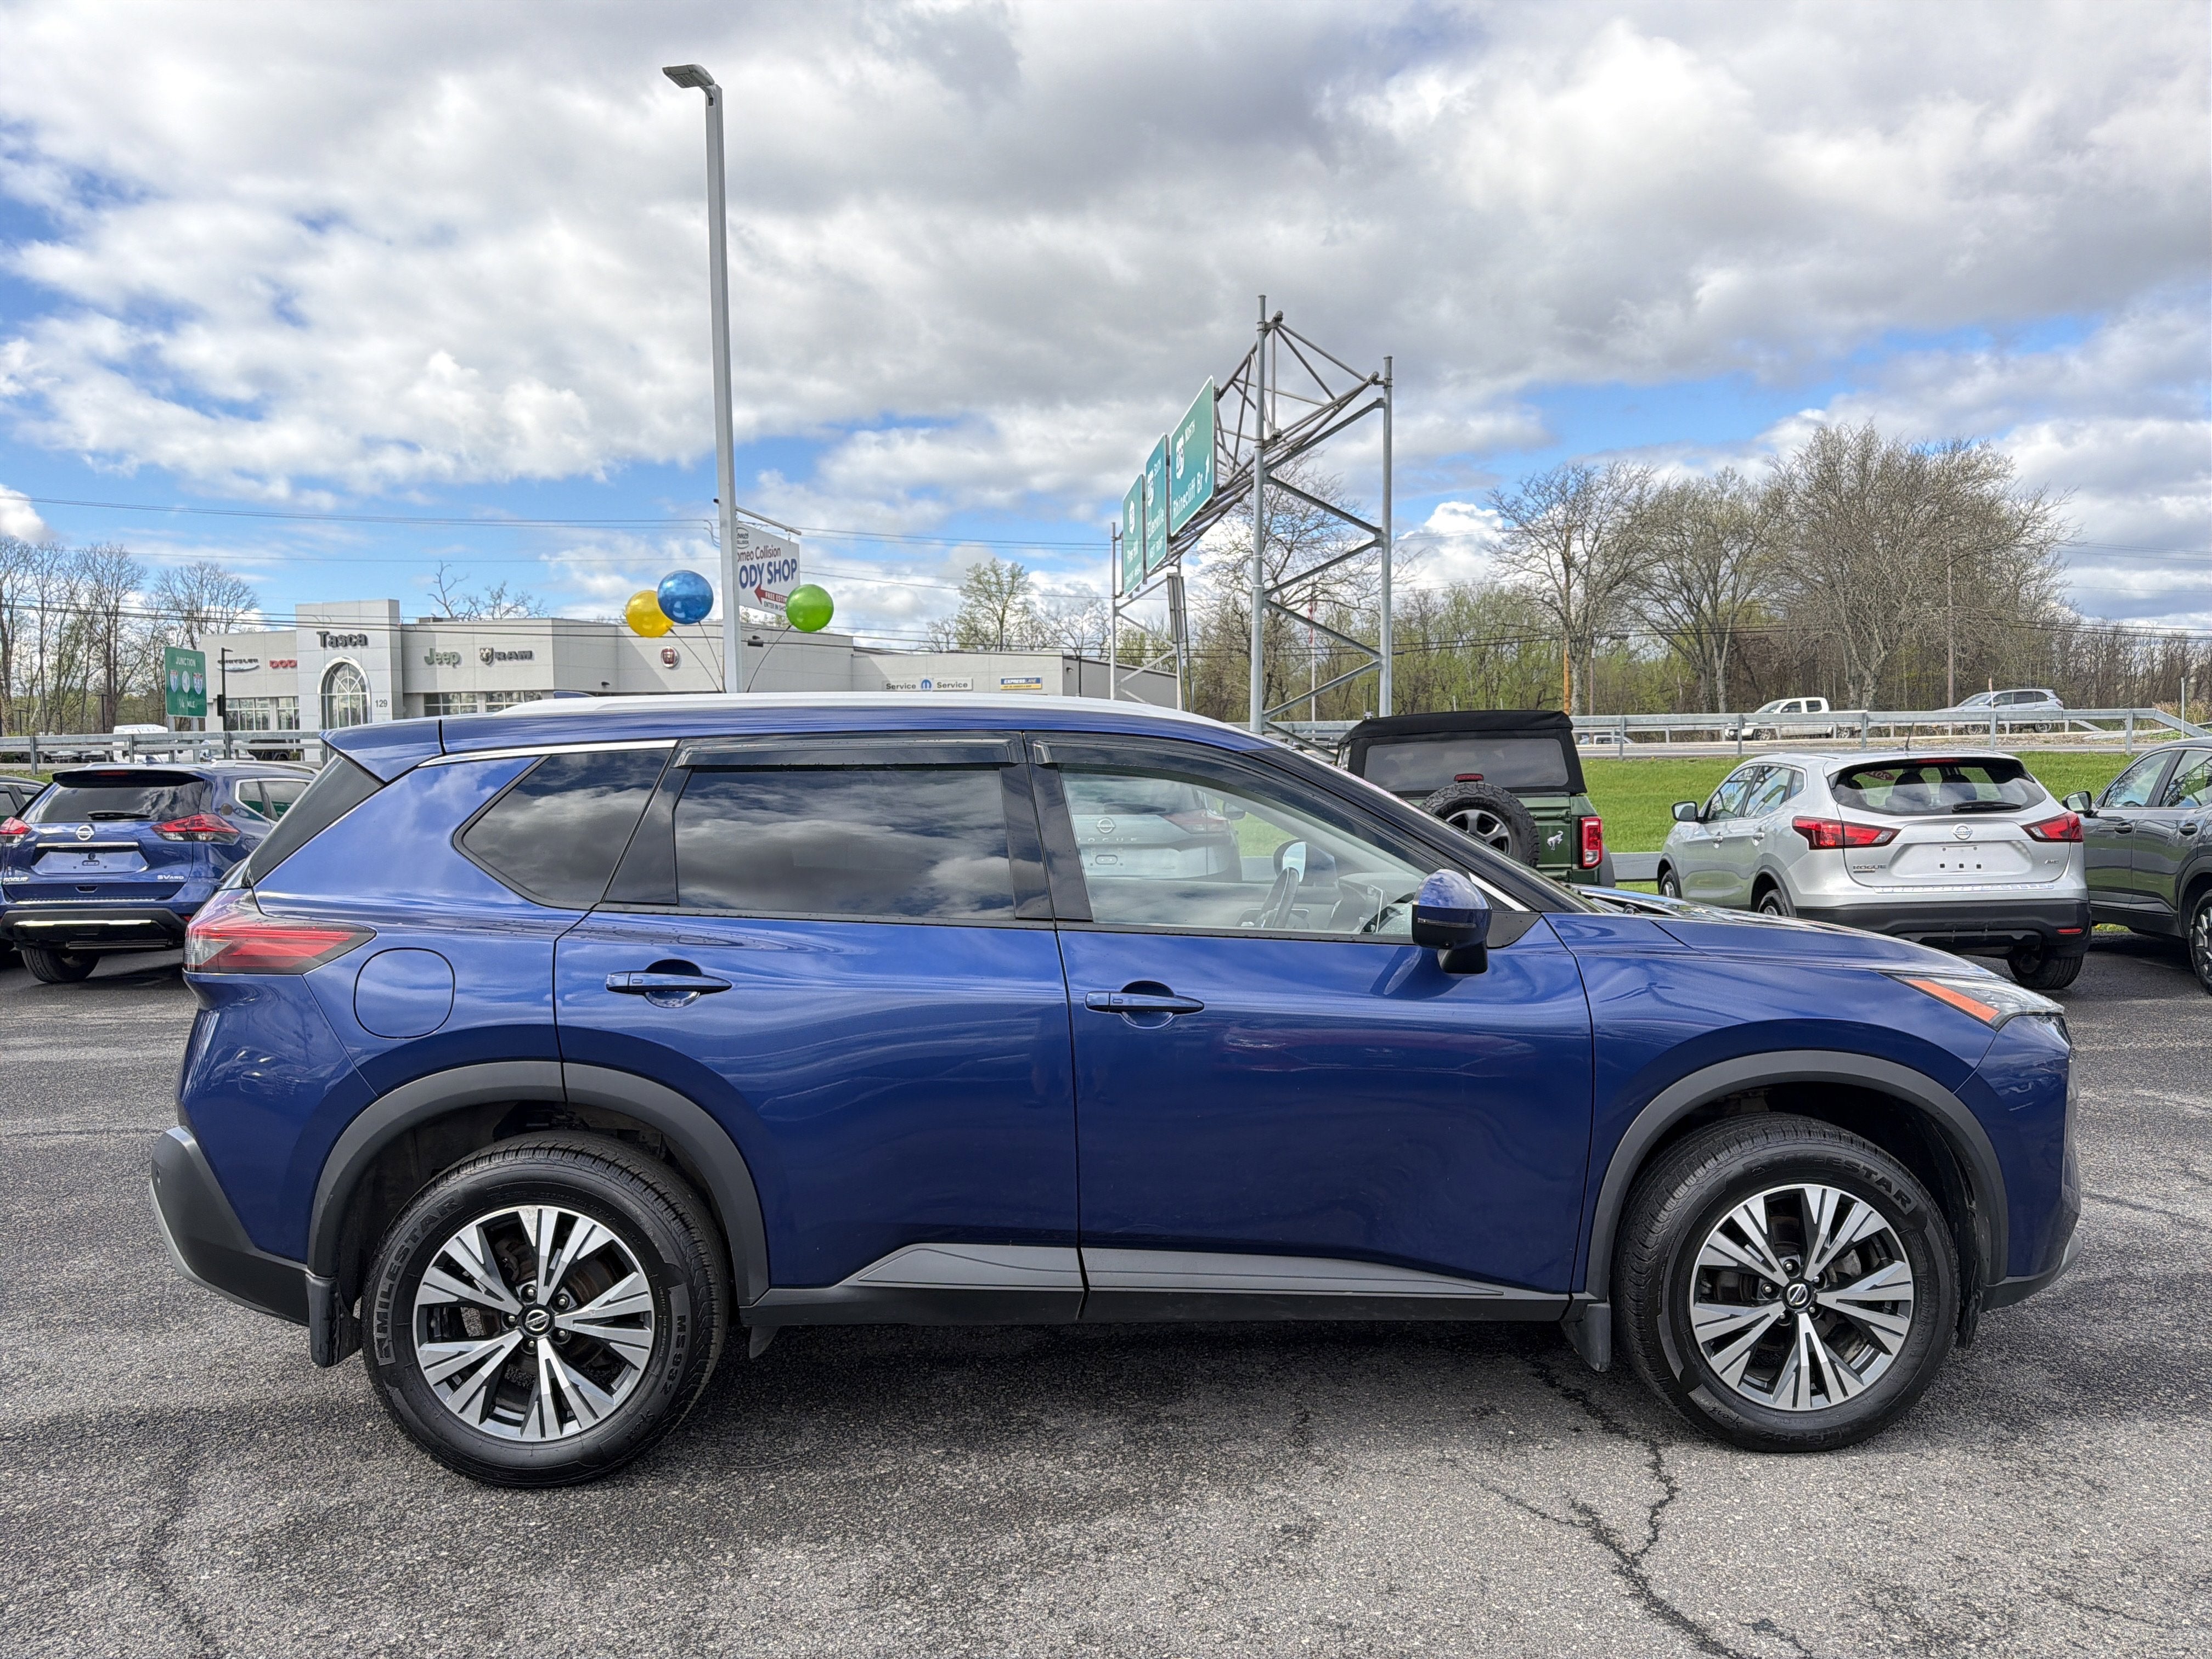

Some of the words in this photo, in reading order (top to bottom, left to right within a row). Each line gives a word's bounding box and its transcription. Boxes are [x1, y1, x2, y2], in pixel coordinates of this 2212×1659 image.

[737, 550, 754, 562] omeo
[755, 545, 781, 560] Collision
[739, 563, 764, 589] ODY
[767, 558, 797, 584] SHOP
[765, 592, 775, 600] FREE
[317, 631, 368, 648] Tasca
[176, 657, 196, 667] JUNCTION
[424, 647, 460, 668] Jeep
[495, 651, 533, 661] RAM
[269, 660, 297, 668] DOD
[375, 699, 388, 708] 129
[376, 1195, 458, 1335] MILESTAR
